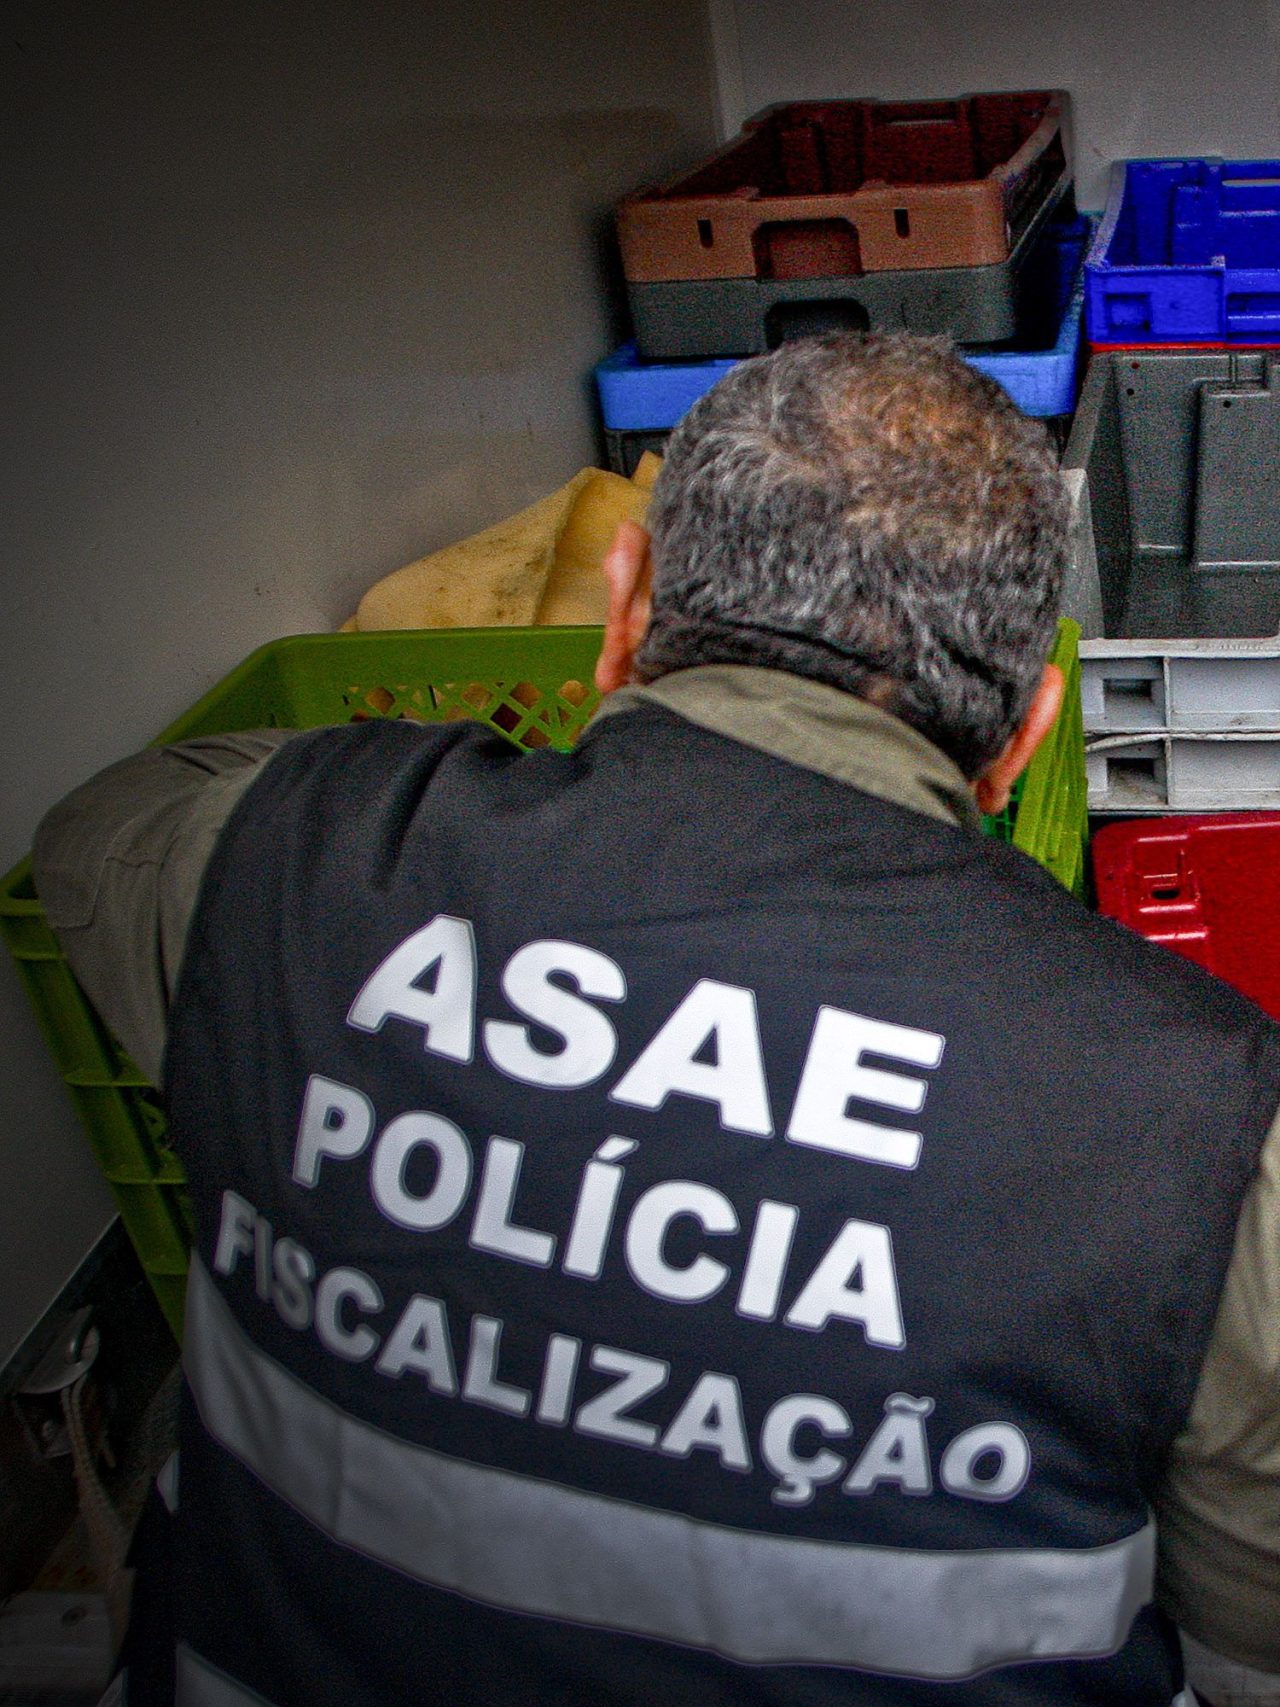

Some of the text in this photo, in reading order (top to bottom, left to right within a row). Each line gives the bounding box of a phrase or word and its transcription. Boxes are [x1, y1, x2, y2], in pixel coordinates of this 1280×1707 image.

[346, 914, 946, 1170] ASAE
[214, 1190, 1032, 1508] FISCALIZAÇÃO
[292, 1074, 906, 1350] POLÍCIA
